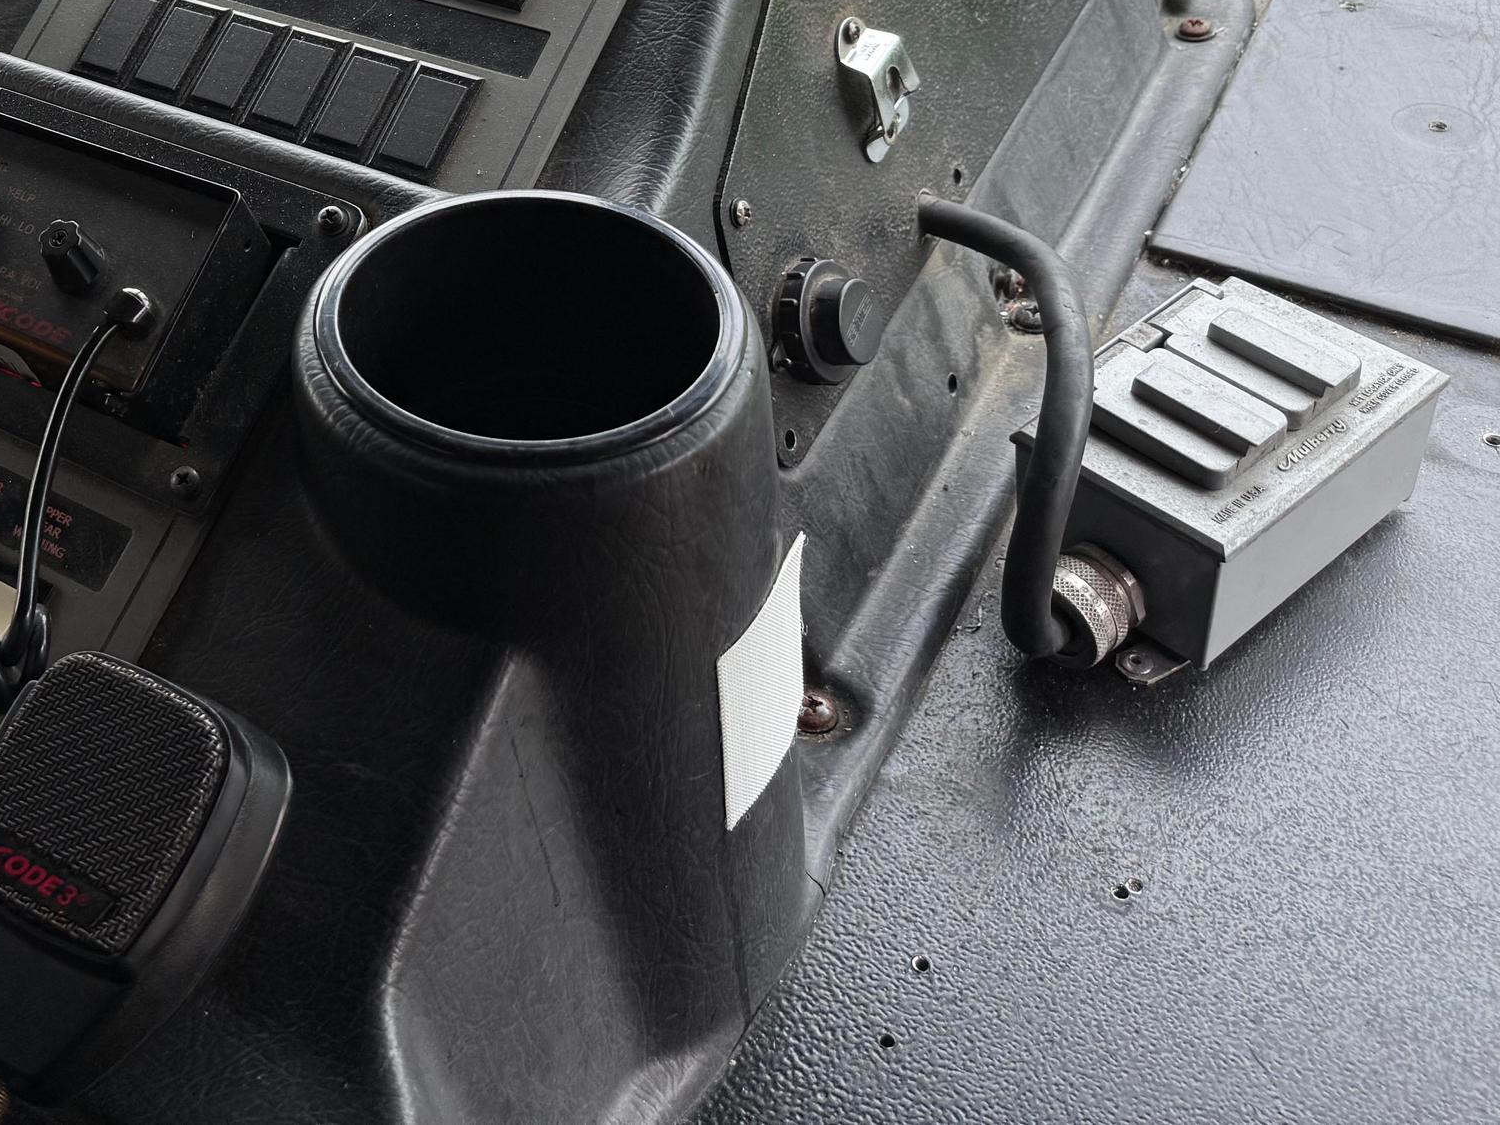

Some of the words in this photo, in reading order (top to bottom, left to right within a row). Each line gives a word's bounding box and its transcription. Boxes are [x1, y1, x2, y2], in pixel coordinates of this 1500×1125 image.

[8, 186, 36, 203] YELP
[1278, 419, 1347, 472] Mulberry
[1212, 504, 1237, 525] MADE
[56, 884, 78, 907] 3
